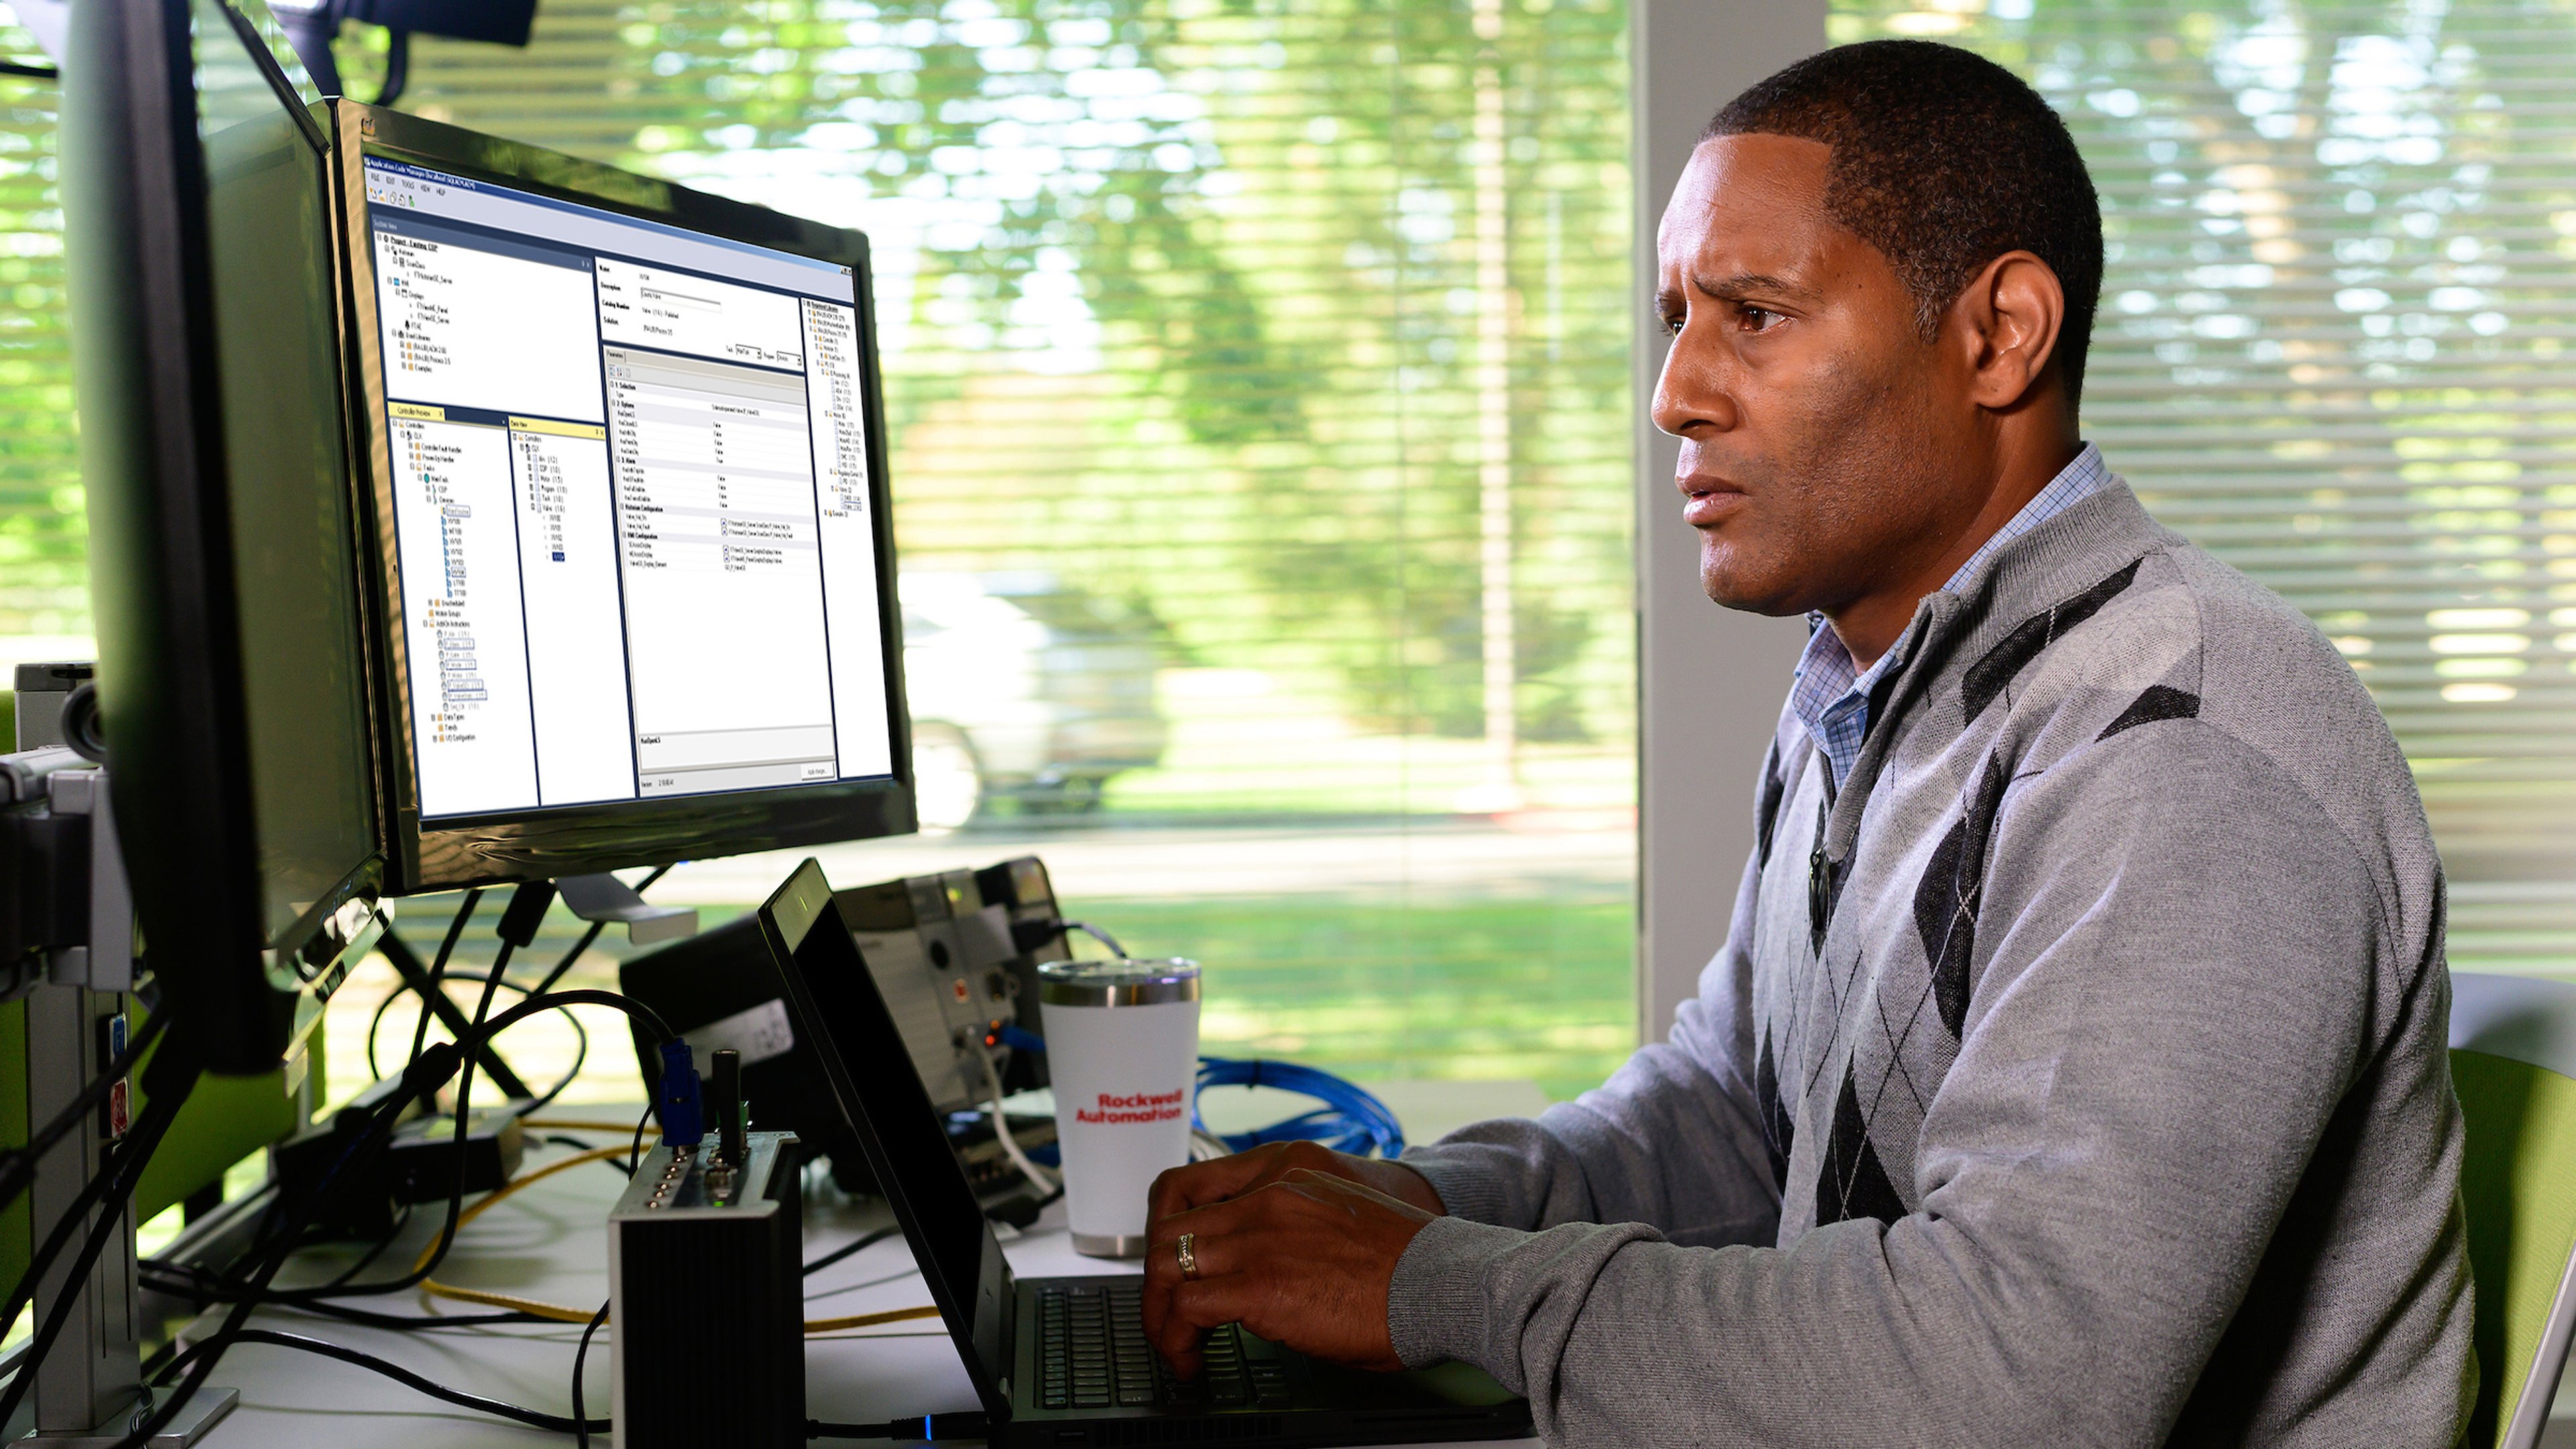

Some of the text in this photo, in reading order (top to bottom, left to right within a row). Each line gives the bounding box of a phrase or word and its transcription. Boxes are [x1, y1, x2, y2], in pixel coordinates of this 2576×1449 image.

[371, 172, 380, 182] FILE
[386, 176, 395, 185] EDIT
[401, 179, 415, 190] TOOLS
[436, 188, 445, 197] HELP
[1097, 1088, 1183, 1108] Rockwell
[1077, 1108, 1181, 1123] Automation
